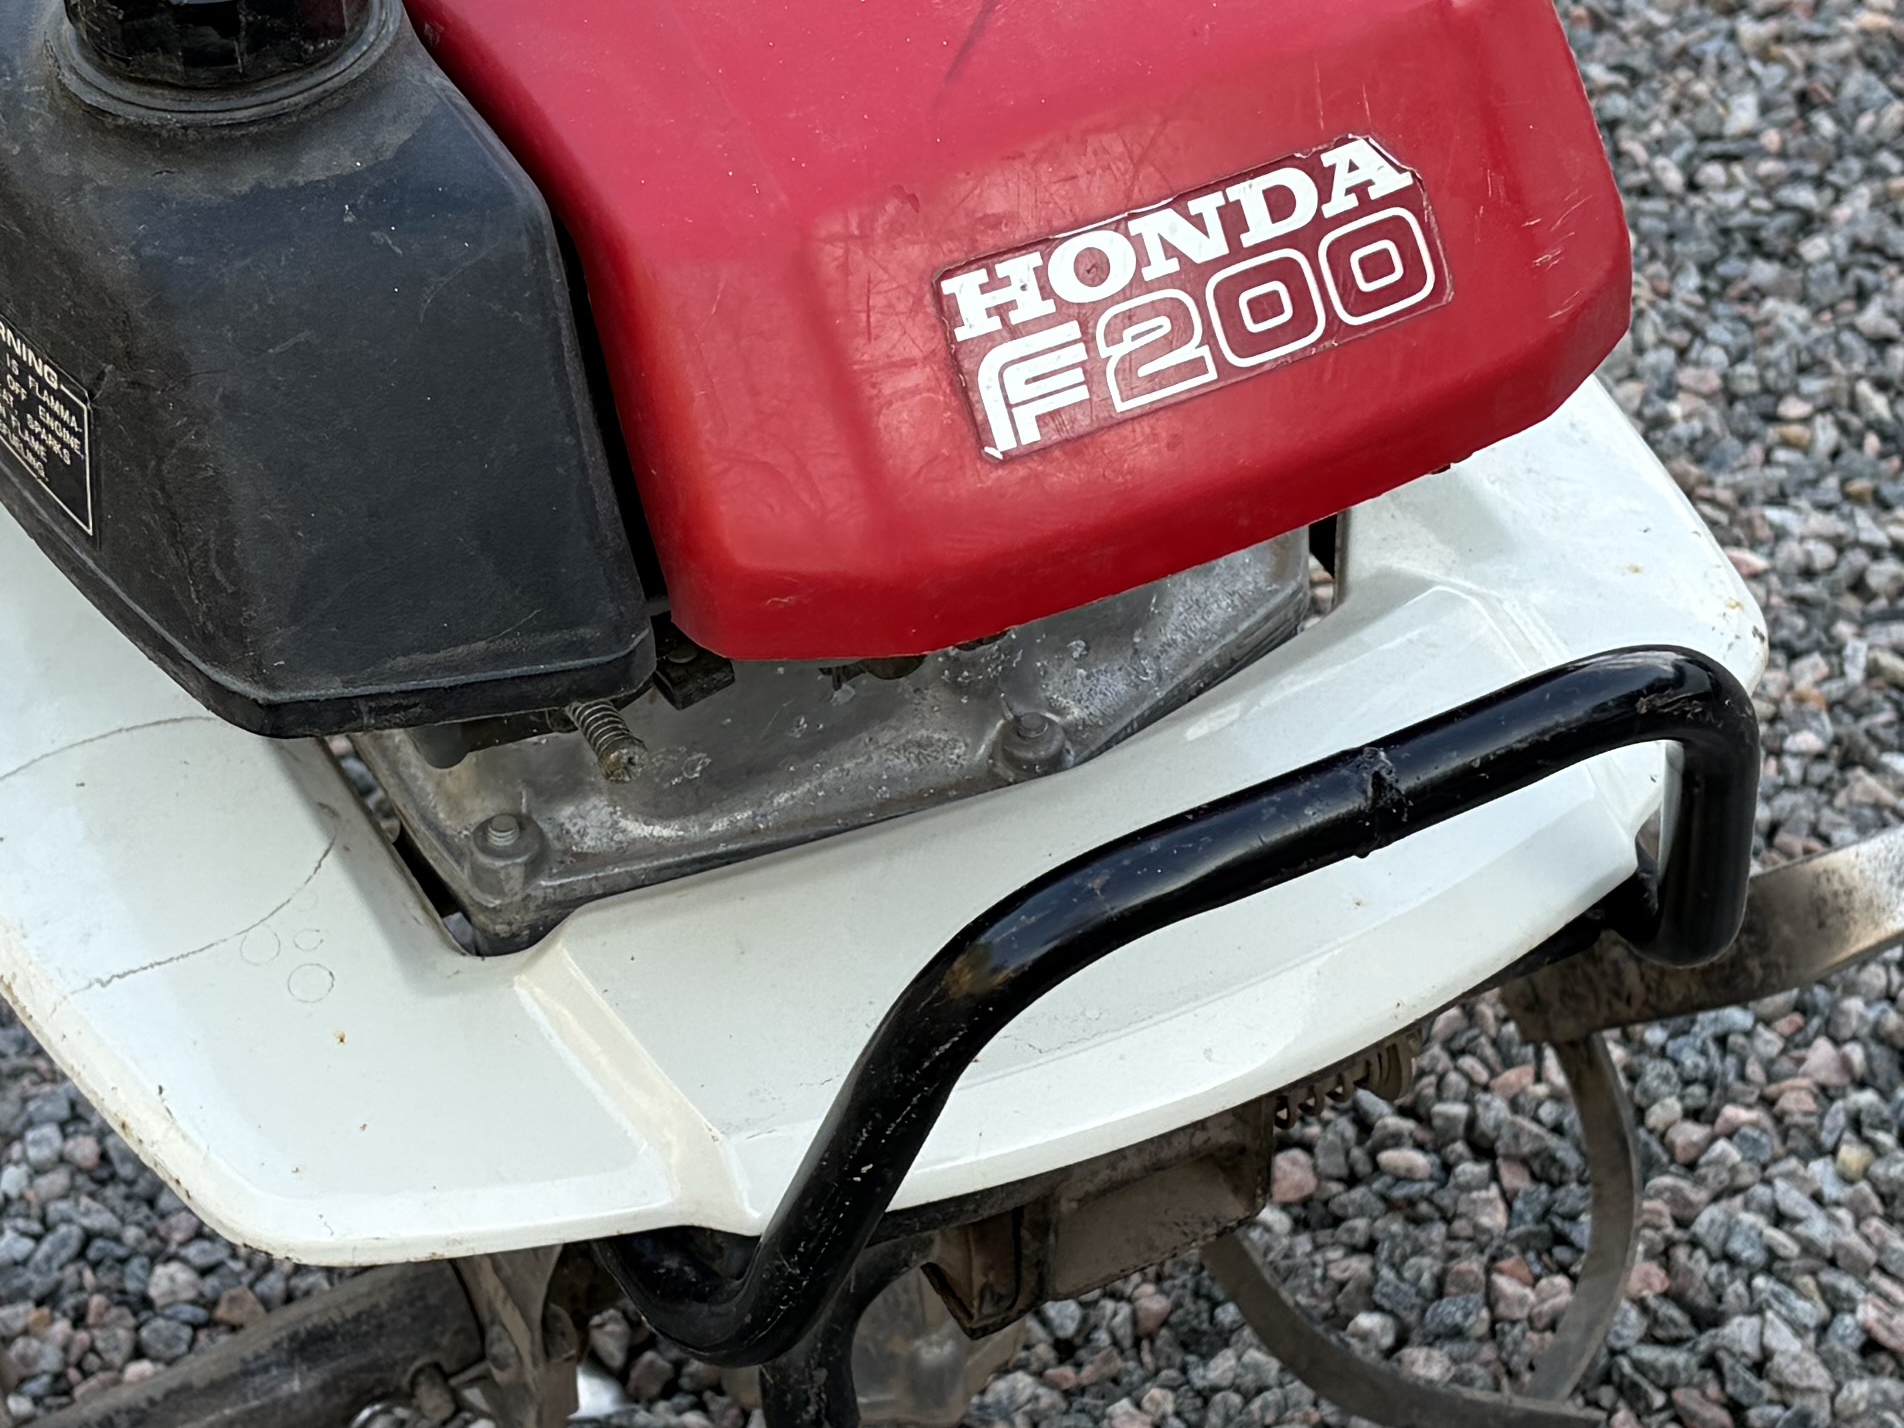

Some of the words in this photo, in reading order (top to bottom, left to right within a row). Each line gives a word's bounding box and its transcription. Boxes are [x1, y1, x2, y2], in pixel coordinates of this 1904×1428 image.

[942, 136, 1413, 342] HONDA
[978, 207, 1435, 452] F200
[6, 353, 19, 375] IS
[6, 374, 27, 401] OFF
[10, 414, 47, 463] FLAME
[26, 413, 71, 465] SPARKS
